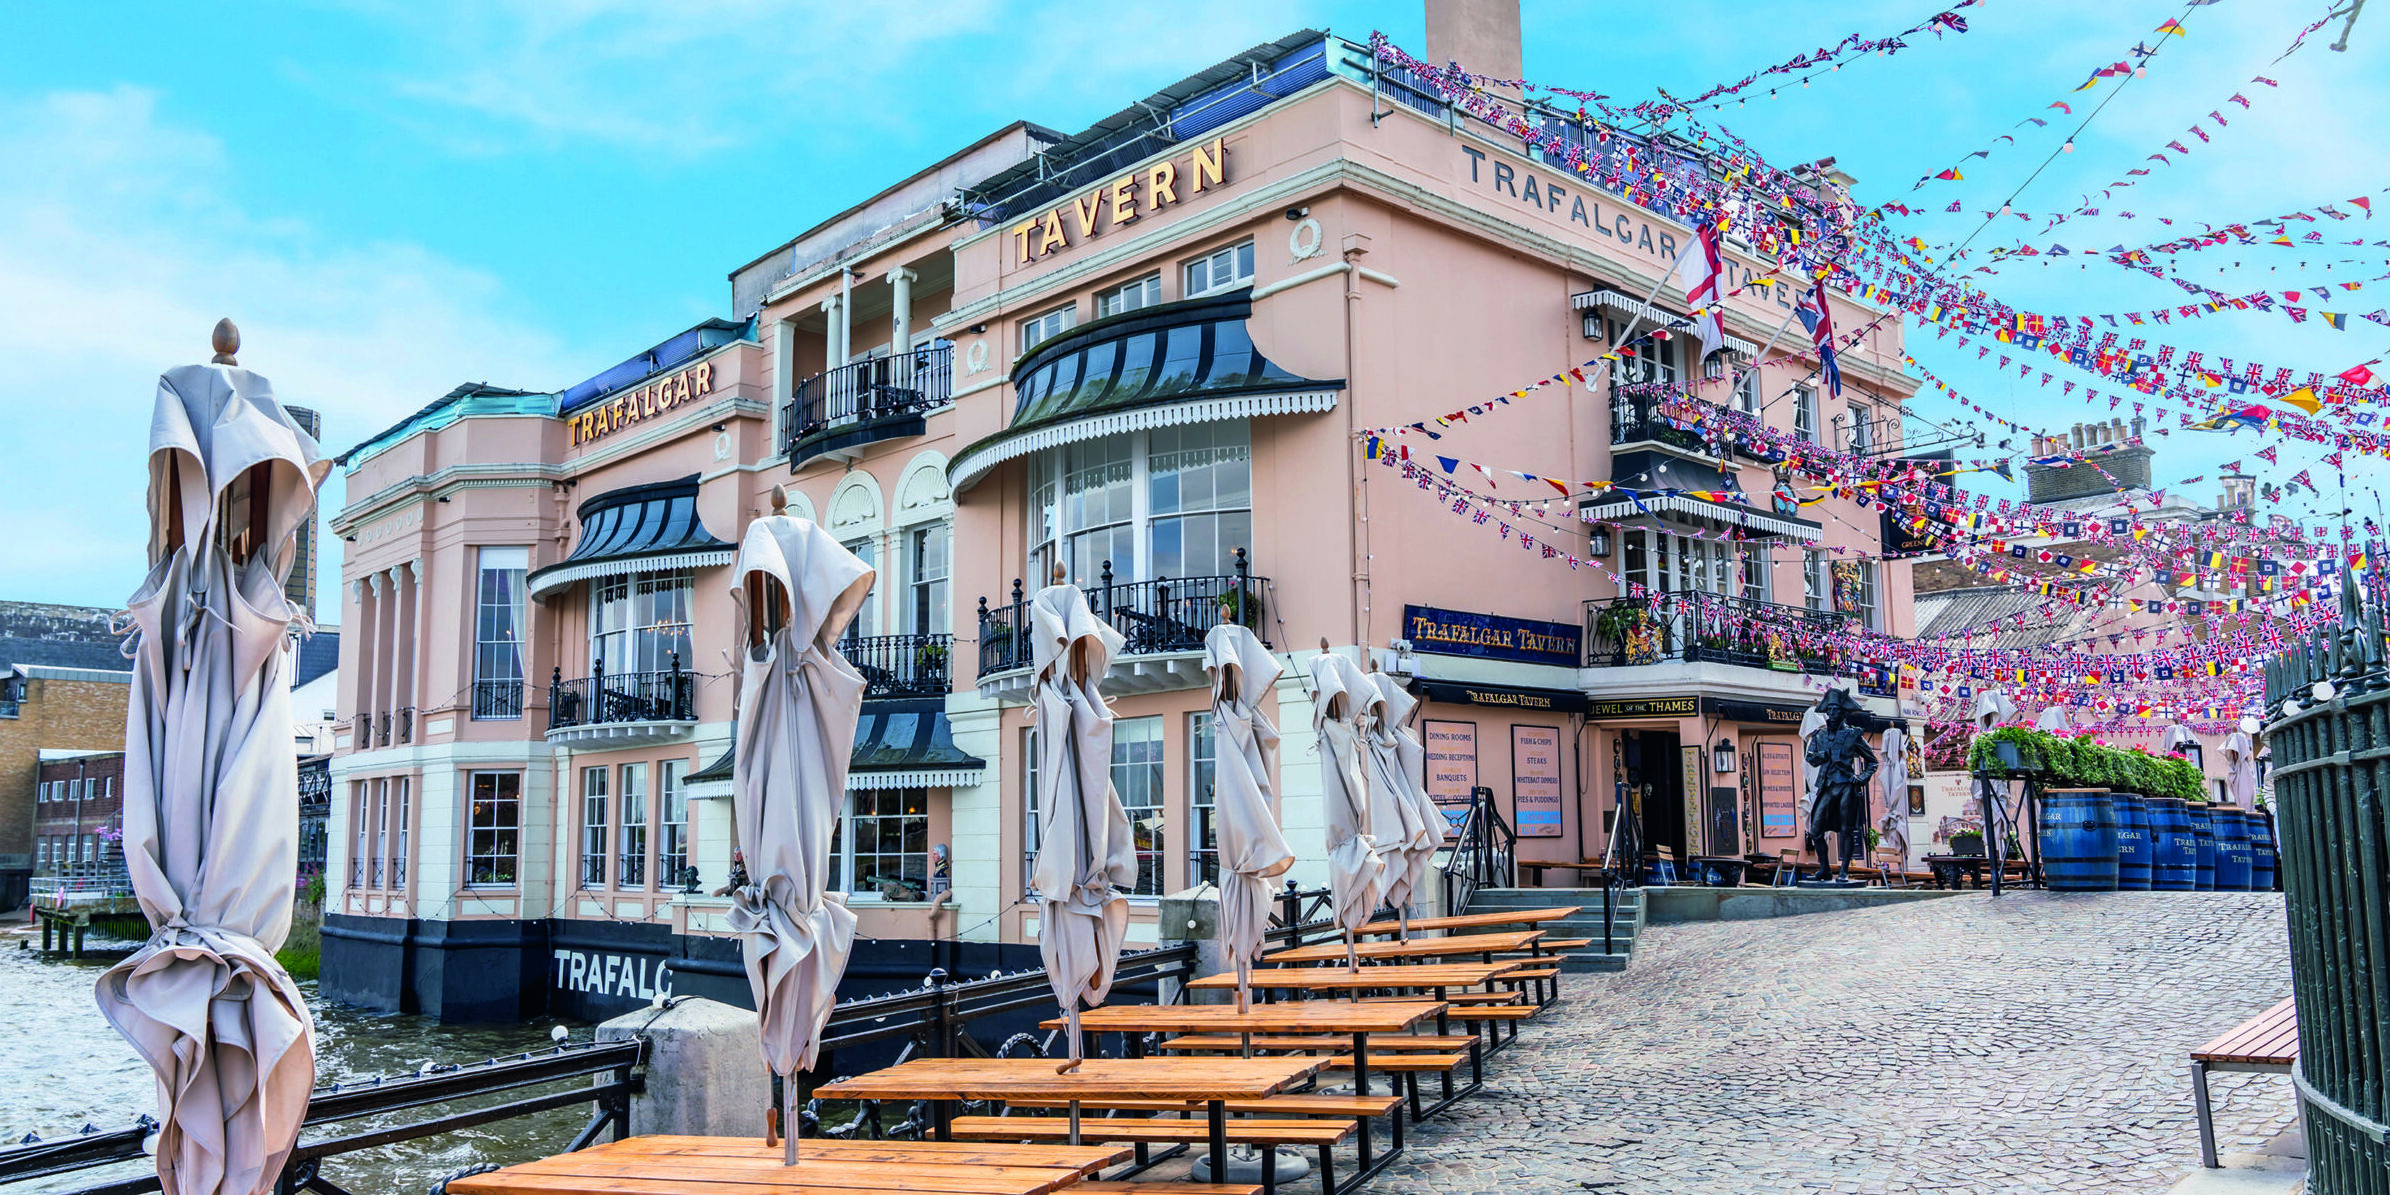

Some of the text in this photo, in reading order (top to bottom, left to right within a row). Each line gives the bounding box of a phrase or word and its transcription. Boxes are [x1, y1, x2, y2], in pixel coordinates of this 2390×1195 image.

[1013, 137, 1224, 263] TAVERN
[1461, 144, 1677, 260] TRAFALGAR
[567, 361, 713, 447] TRAFALGAR
[1412, 616, 1577, 655] TRAFALGAR TAVERN
[1466, 689, 1551, 708] TRAFALGAR TAVERN
[1590, 703, 1623, 715] JEWEL
[1648, 700, 1695, 713] THAMES
[1429, 732, 1472, 742] DINING ROOMS
[1520, 737, 1532, 745] FISH
[1537, 738, 1552, 746] CHIPS
[1527, 757, 1547, 765] STEAKS
[1436, 774, 1467, 782] BANQUETS
[1534, 796, 1559, 804] PUDDINGS
[554, 949, 674, 1001] TRAFALG
